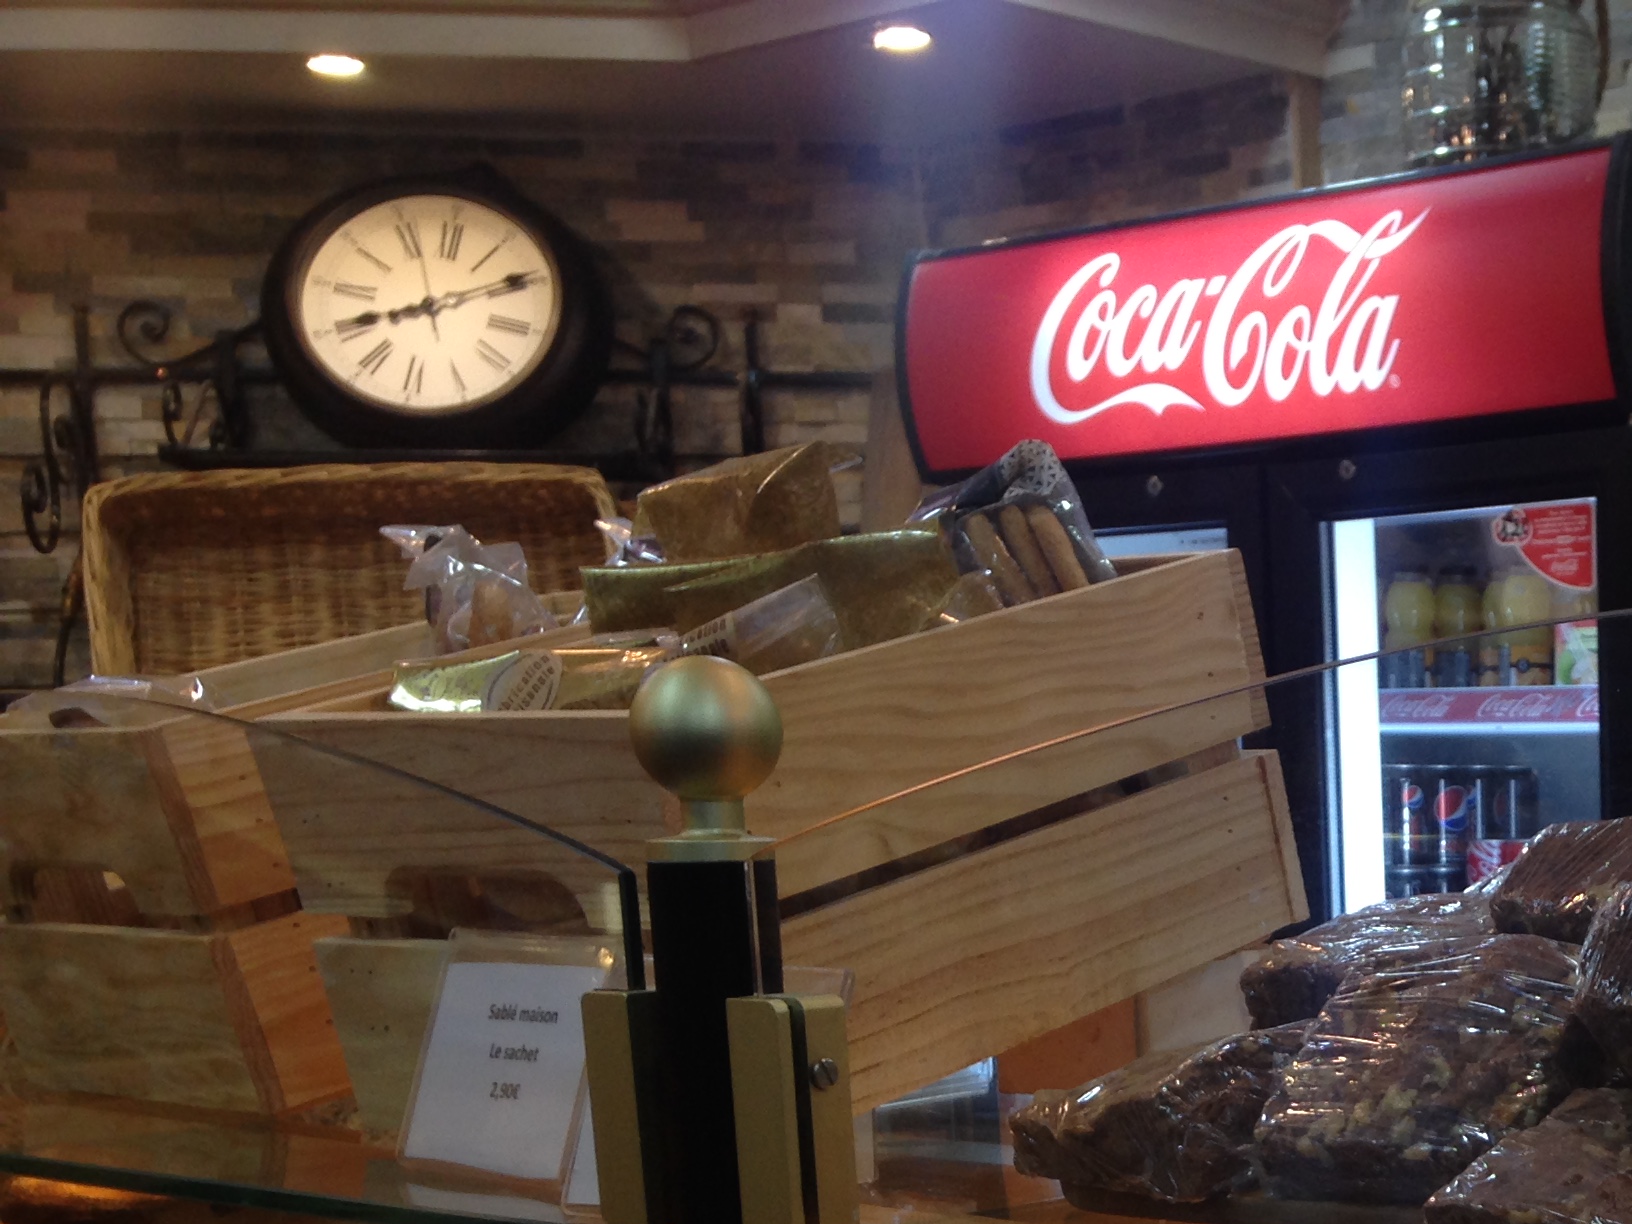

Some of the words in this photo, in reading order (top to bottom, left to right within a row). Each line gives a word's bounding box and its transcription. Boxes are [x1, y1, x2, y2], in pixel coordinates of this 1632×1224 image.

[1030, 206, 1432, 424] Coca-Cola
[519, 1006, 558, 1023] maison
[489, 1043, 502, 1059] Le
[503, 1044, 539, 1062] sachet
